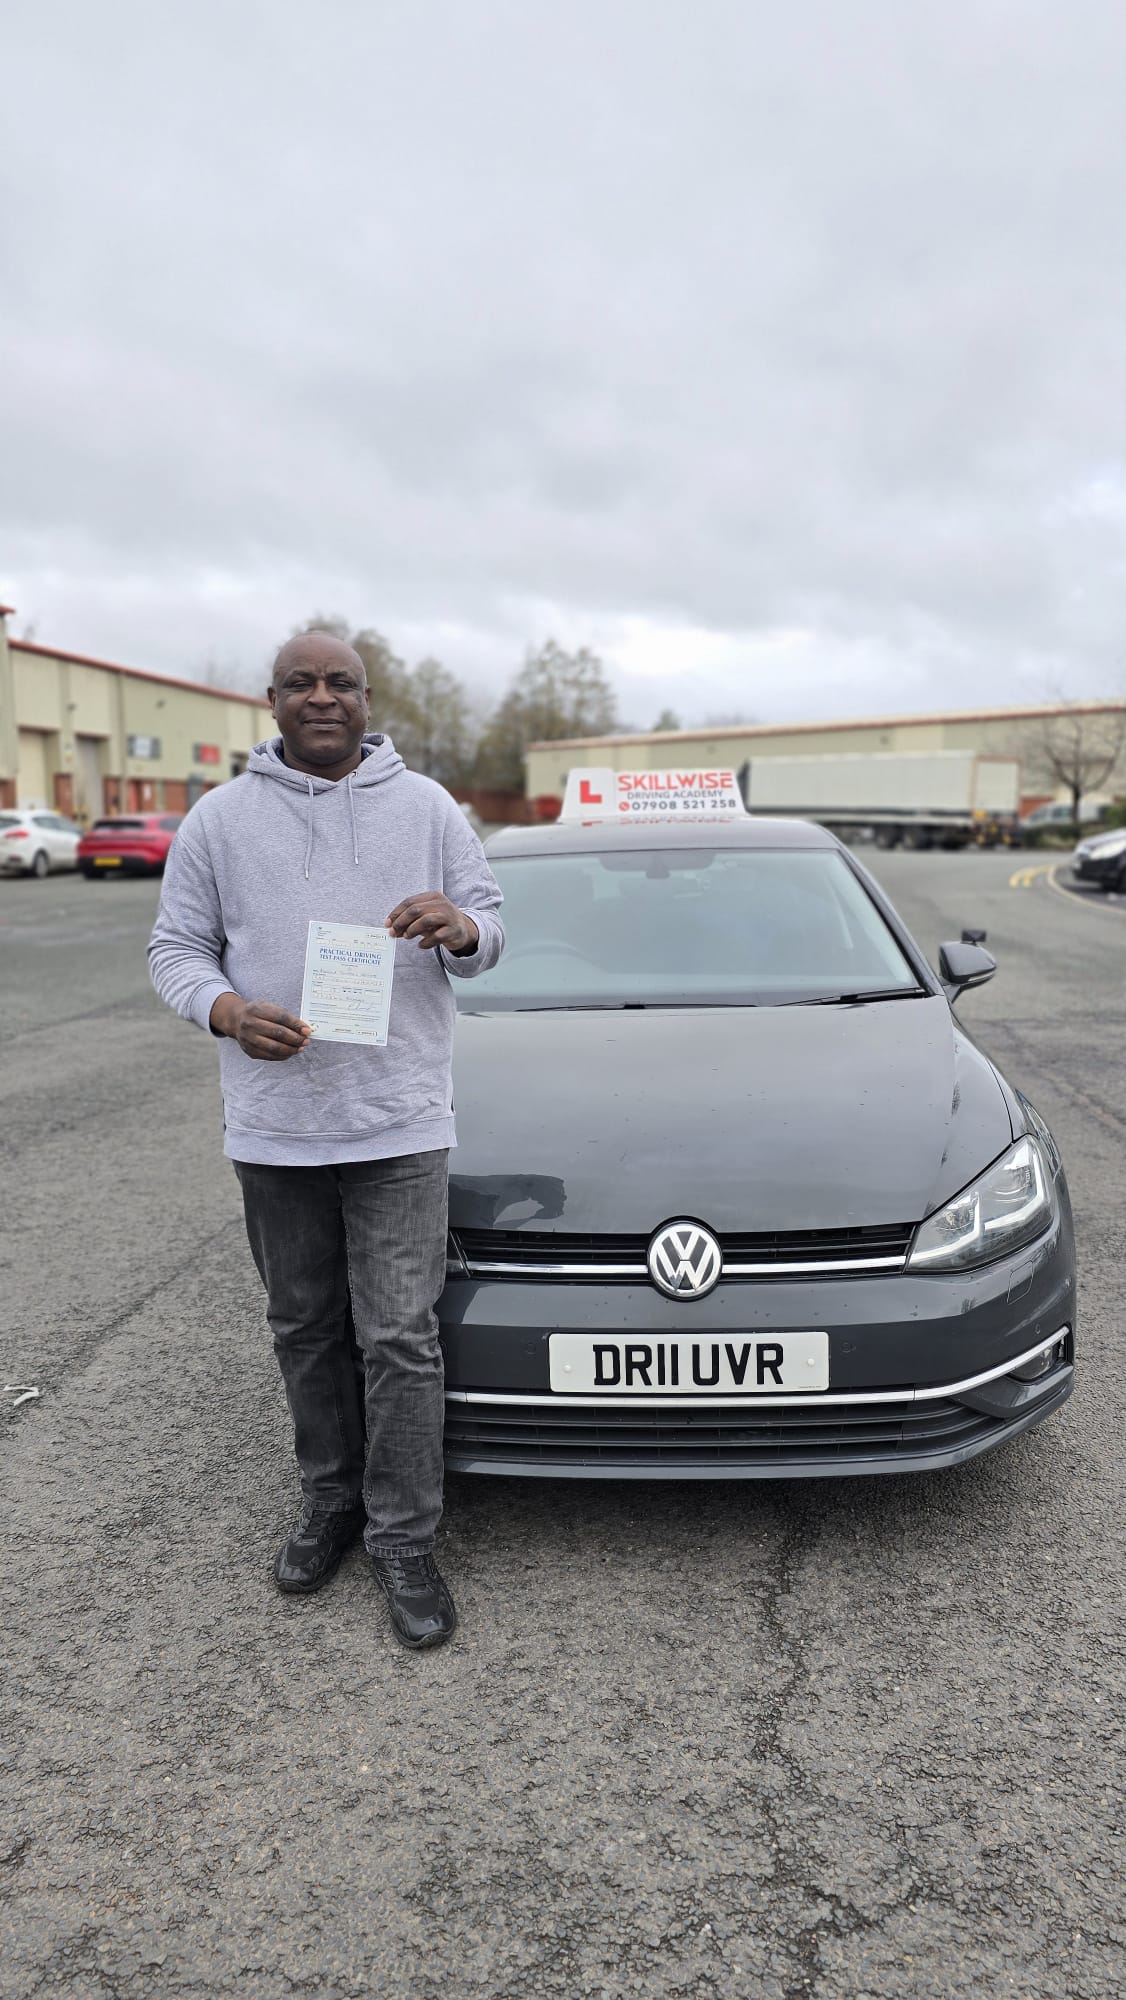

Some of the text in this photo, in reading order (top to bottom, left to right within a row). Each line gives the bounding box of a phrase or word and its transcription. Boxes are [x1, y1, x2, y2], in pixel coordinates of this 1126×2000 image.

[617, 772, 733, 791] SKILLWISE
[580, 780, 602, 804] L
[627, 789, 724, 800] DRIVING ACADEMY
[631, 799, 736, 810] 07908 521 258
[319, 948, 382, 960] PRACTICAL DRIVING
[347, 957, 381, 965] CERTIFICATE
[691, 1342, 784, 1386] UVR
